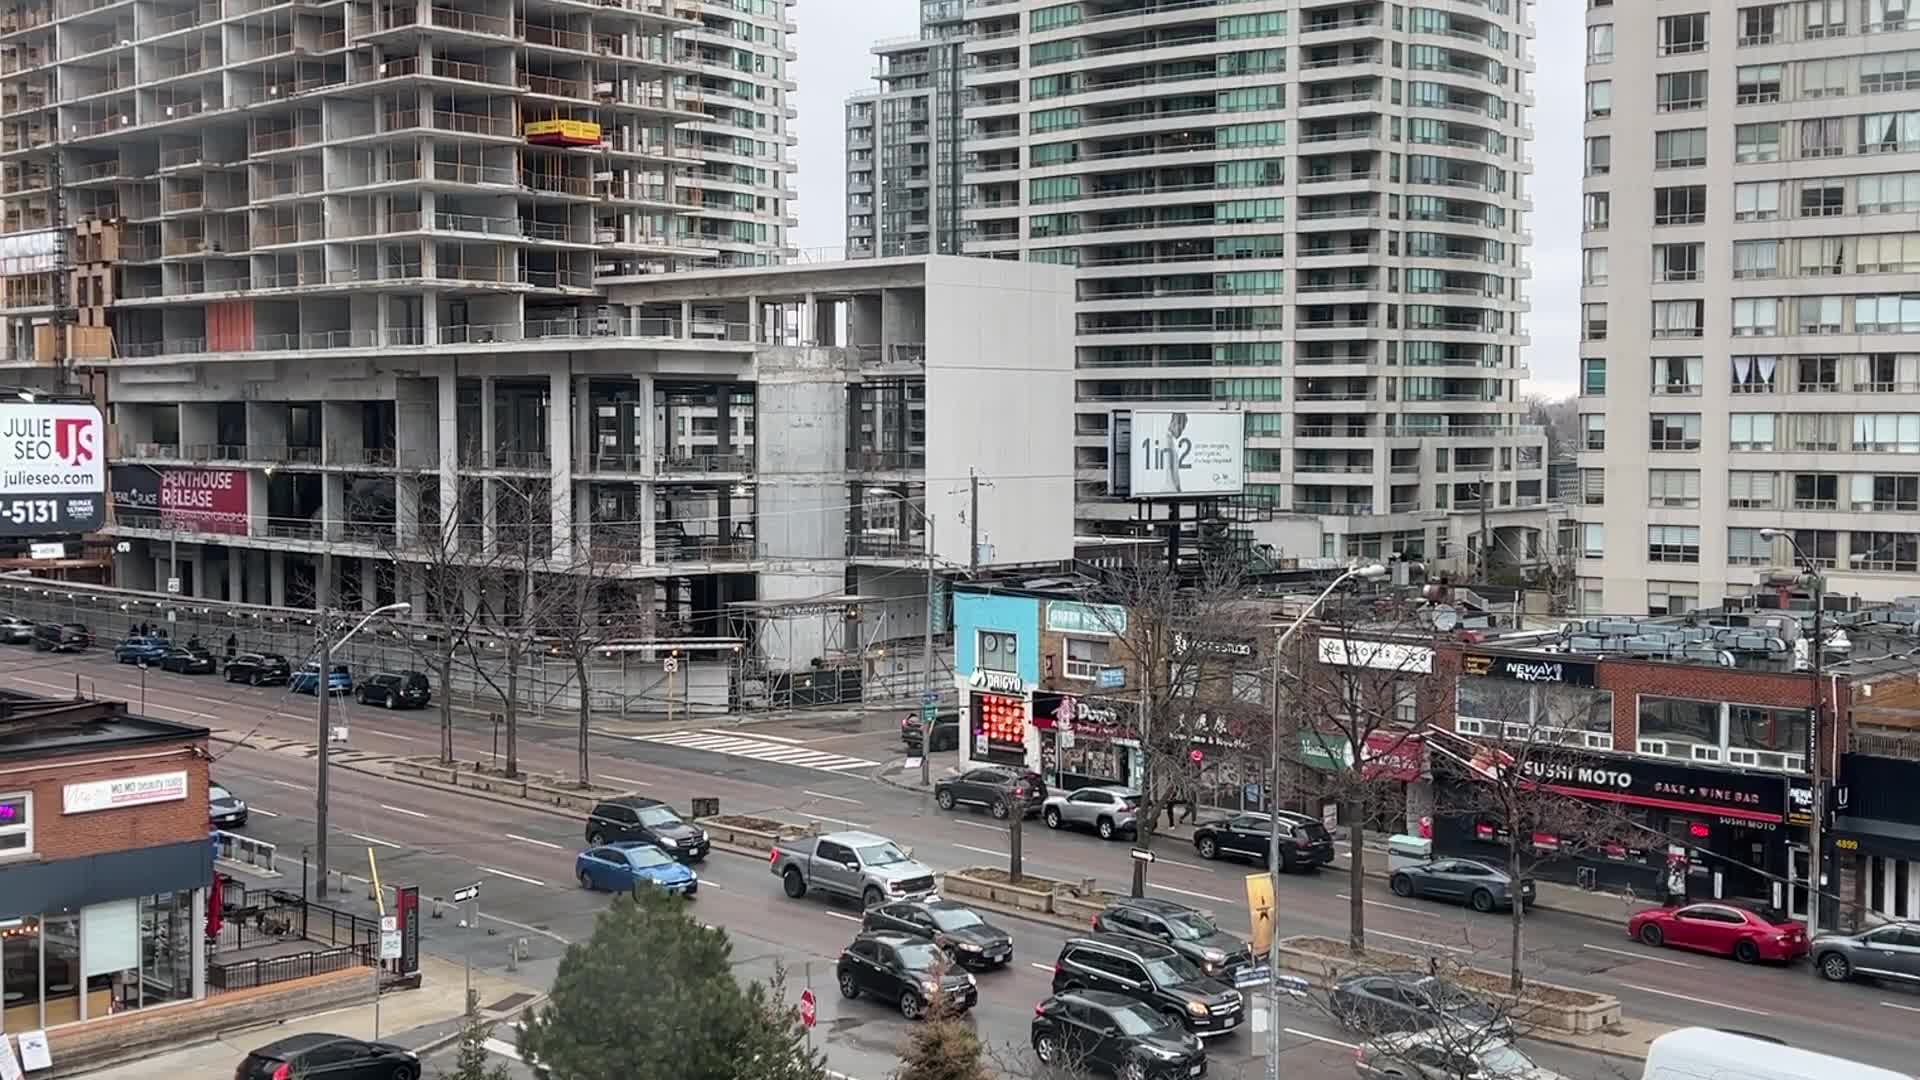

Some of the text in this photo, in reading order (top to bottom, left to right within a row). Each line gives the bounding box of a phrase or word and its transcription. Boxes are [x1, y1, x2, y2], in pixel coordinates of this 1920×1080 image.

[4, 419, 51, 437] JULIE
[15, 441, 51, 460] SEO
[4, 470, 94, 488] julieseo.com
[162, 471, 233, 489] PENTHOUSE
[162, 489, 213, 507] RELEASE
[1506, 662, 1553, 675] NEWAY
[988, 673, 1022, 692] DAIGYO
[1523, 761, 1633, 788] SUSHI MOTO
[1654, 781, 1760, 804] SAKE WINE BAR
[1719, 815, 1777, 832] SUSHI MOTO
[1835, 839, 1858, 850] 4899
